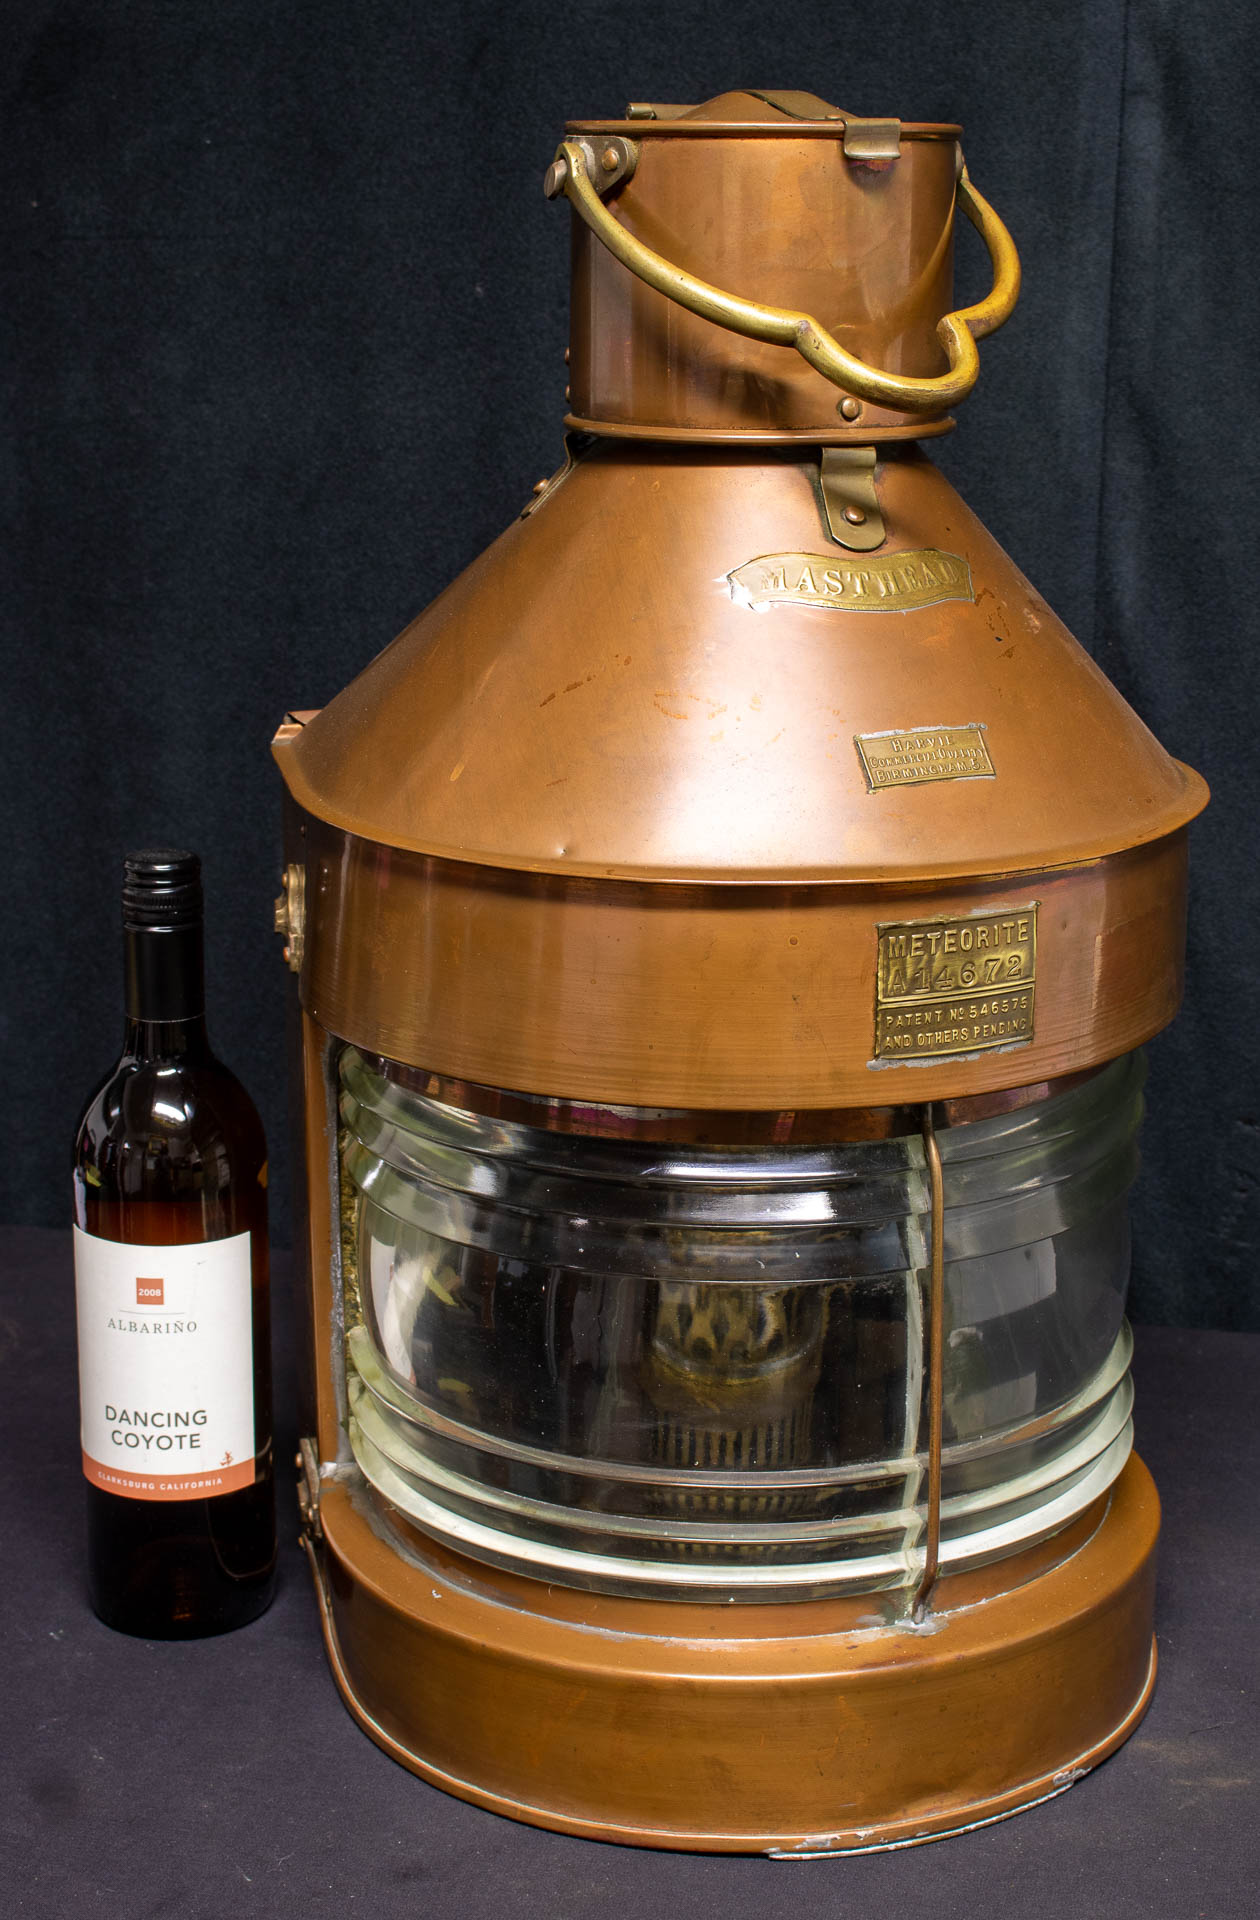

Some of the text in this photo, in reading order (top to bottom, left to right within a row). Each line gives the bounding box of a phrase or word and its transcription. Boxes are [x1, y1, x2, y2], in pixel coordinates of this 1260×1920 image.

[760, 559, 960, 598] MASTHEAD
[888, 919, 1029, 958] METEORITE
[886, 1010, 943, 1028] PATENT
[969, 997, 1027, 1019] 546575
[885, 1018, 1027, 1049] AND OTHERS PENDING
[138, 1288, 161, 1297] 2008
[107, 1318, 198, 1334] ALBARIÑO
[105, 1405, 207, 1428] DANCING
[111, 1430, 201, 1450] COYOTE
[97, 1472, 222, 1490] CLARKSBURG CALIFORNIA
